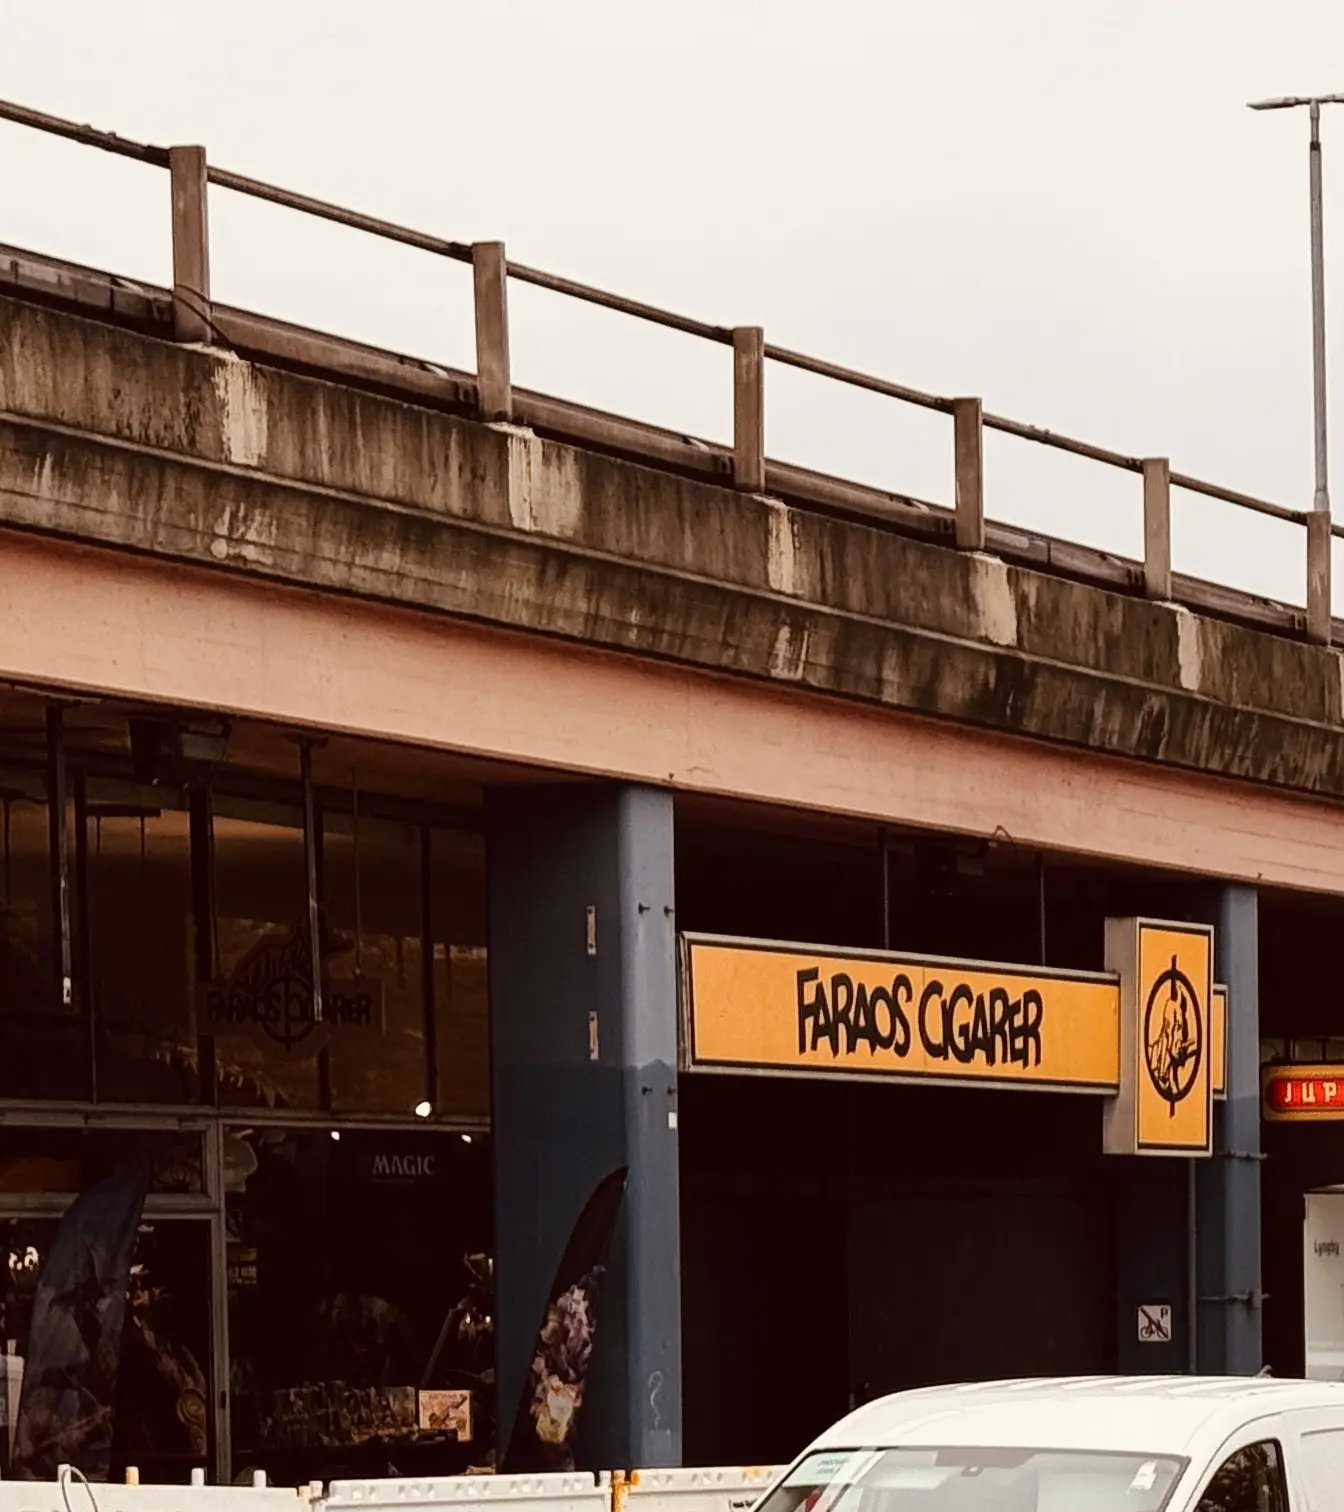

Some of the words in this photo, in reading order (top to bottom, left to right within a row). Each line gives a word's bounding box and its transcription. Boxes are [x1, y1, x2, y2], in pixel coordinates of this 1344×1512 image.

[797, 966, 913, 1058] FARAOS
[918, 980, 1043, 1070] CIGARER
[371, 1152, 436, 1177] MAGIC
